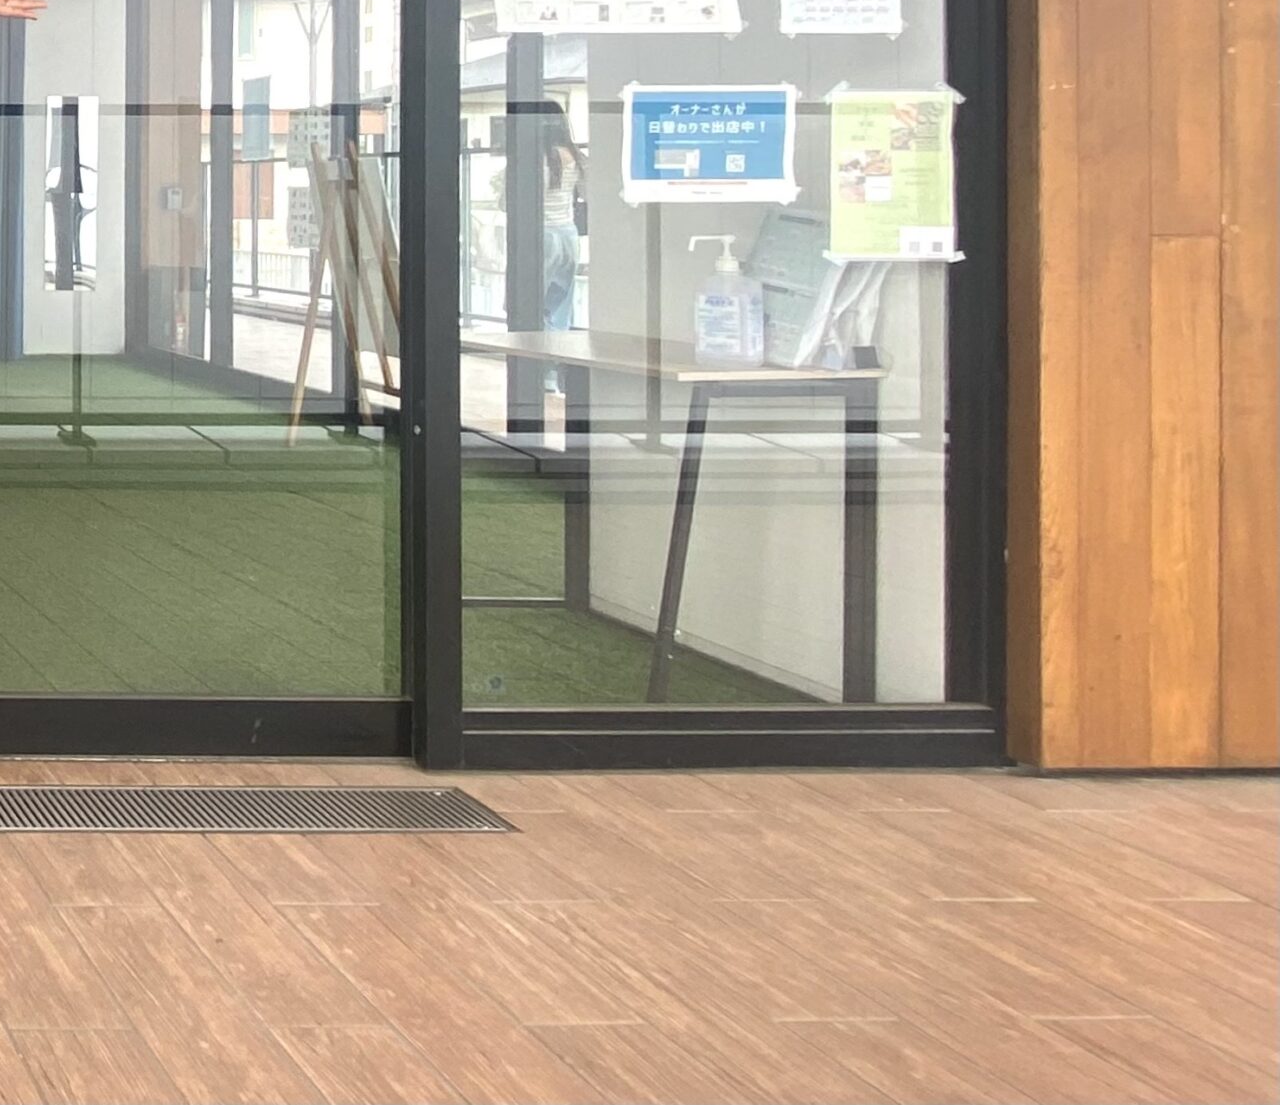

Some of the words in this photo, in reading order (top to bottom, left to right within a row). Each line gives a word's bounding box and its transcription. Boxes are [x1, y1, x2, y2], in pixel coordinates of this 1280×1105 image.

[670, 102, 746, 116] オーナーさんが
